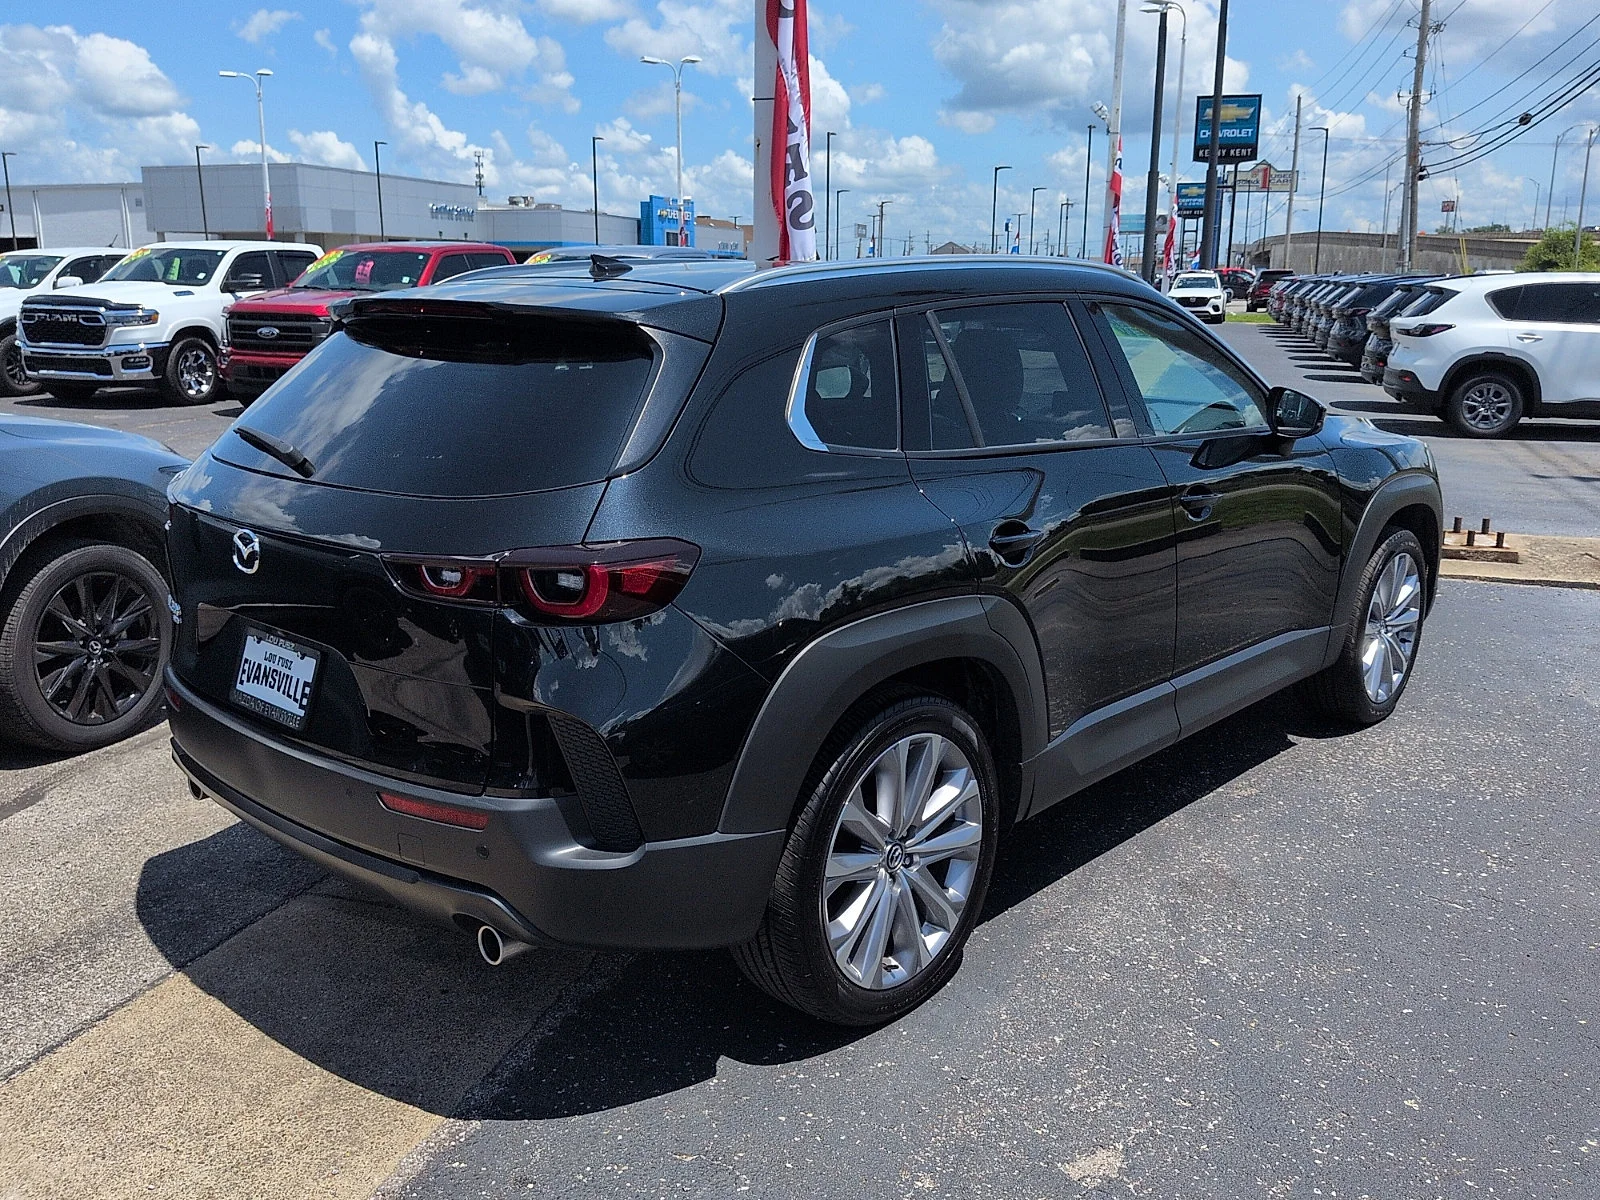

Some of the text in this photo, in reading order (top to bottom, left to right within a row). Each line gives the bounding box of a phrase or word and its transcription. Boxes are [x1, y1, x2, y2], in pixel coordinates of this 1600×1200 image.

[1200, 129, 1253, 138] CHVROLET
[1230, 148, 1252, 157] KENT
[265, 633, 295, 650] LOU FUSZ
[264, 651, 294, 671] LOU FUSZ
[238, 657, 311, 710] EVANSVILLE
